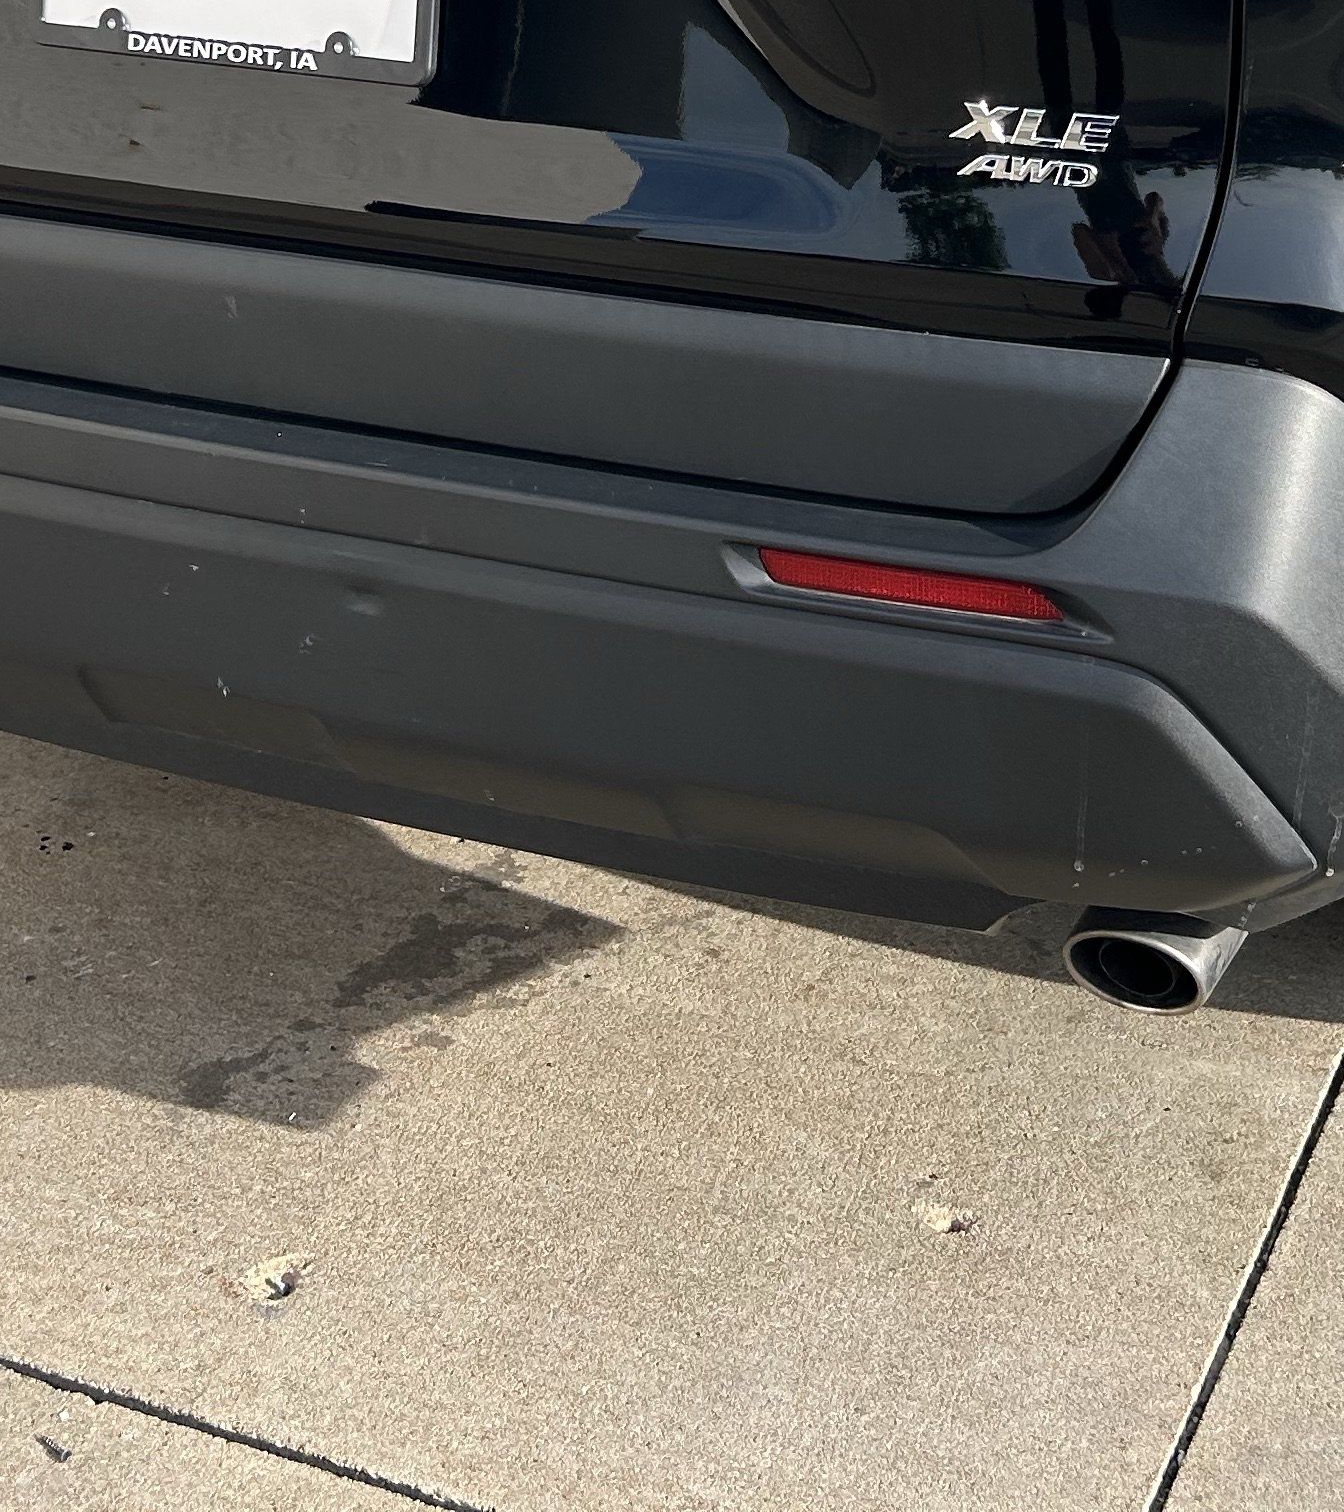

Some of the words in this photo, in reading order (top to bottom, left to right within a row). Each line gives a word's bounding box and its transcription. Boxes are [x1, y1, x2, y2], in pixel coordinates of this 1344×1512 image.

[127, 33, 284, 70] DAVENPORT,
[289, 50, 318, 72] IA
[948, 99, 1120, 153] XLE
[956, 154, 1099, 188] AWD
